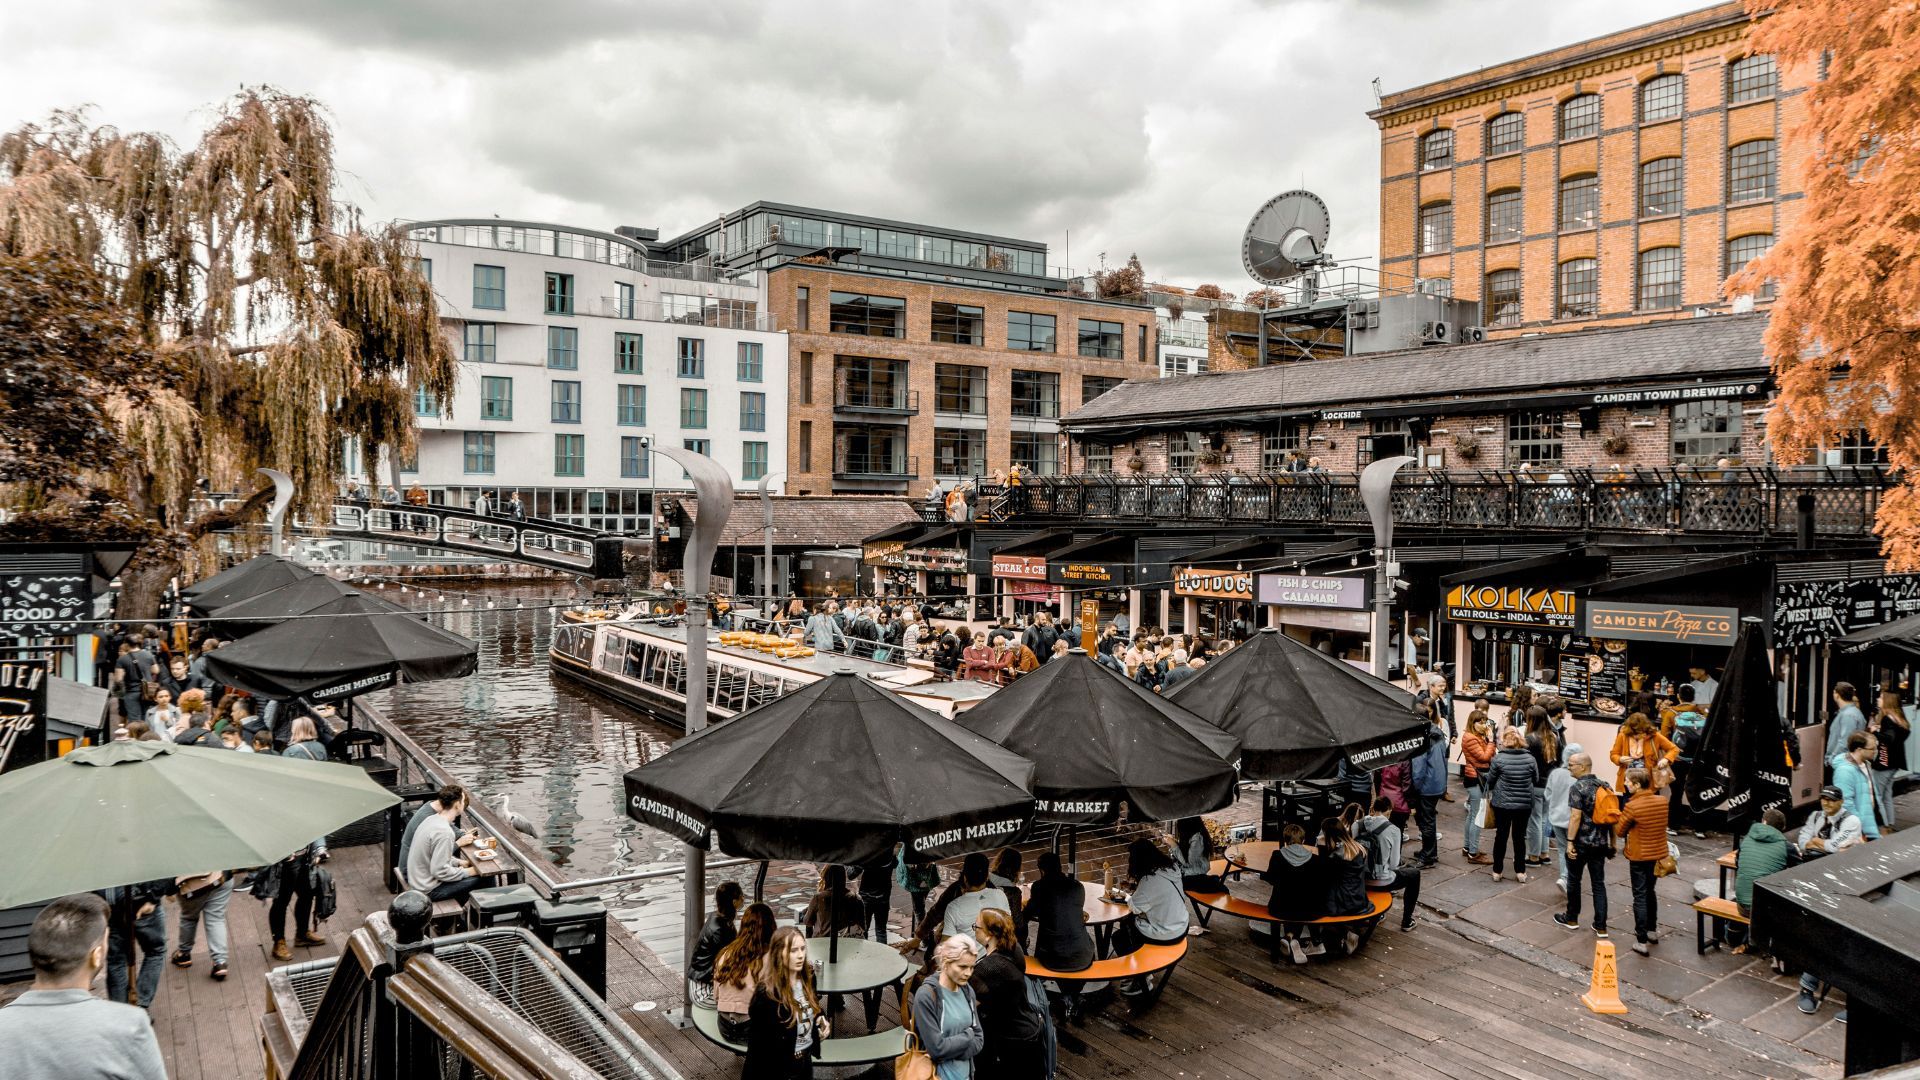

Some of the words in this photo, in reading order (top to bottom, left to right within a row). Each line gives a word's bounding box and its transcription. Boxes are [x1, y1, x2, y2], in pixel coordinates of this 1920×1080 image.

[1594, 392, 1641, 403] CAMDEN
[1644, 389, 1680, 400] TOWN
[1682, 385, 1744, 398] BREWERY
[1323, 411, 1362, 420] LOCKSIDE
[995, 563, 1022, 574] STEAK
[1024, 566, 1030, 574] &
[1086, 572, 1111, 580] KITCHEN
[1278, 578, 1299, 588] FISH
[1301, 579, 1309, 589] &
[1311, 580, 1343, 591] CHIPS
[1282, 592, 1338, 604] CALAMARI
[1461, 584, 1575, 613] KOLKAT
[3, 607, 56, 621] FOOD
[1452, 609, 1471, 618] KATI
[1473, 610, 1499, 620] ROLLS
[1507, 612, 1533, 622] INDIA
[1787, 608, 1811, 623] WEST
[1811, 606, 1834, 620] YARD
[1593, 614, 1657, 628] CAMDEN
[1661, 610, 1702, 639] Pizza
[1706, 621, 1730, 632] CO
[312, 682, 352, 698] CAMDEN
[353, 672, 392, 689] MARKET
[1350, 748, 1380, 765] CAMDEN
[1382, 736, 1425, 756] MARKET
[1053, 801, 1110, 813] MARKET
[632, 795, 675, 820] CAMDEN
[675, 810, 706, 837] MARKET
[914, 828, 962, 851] CAMDEN
[966, 818, 1024, 839] MARKET
